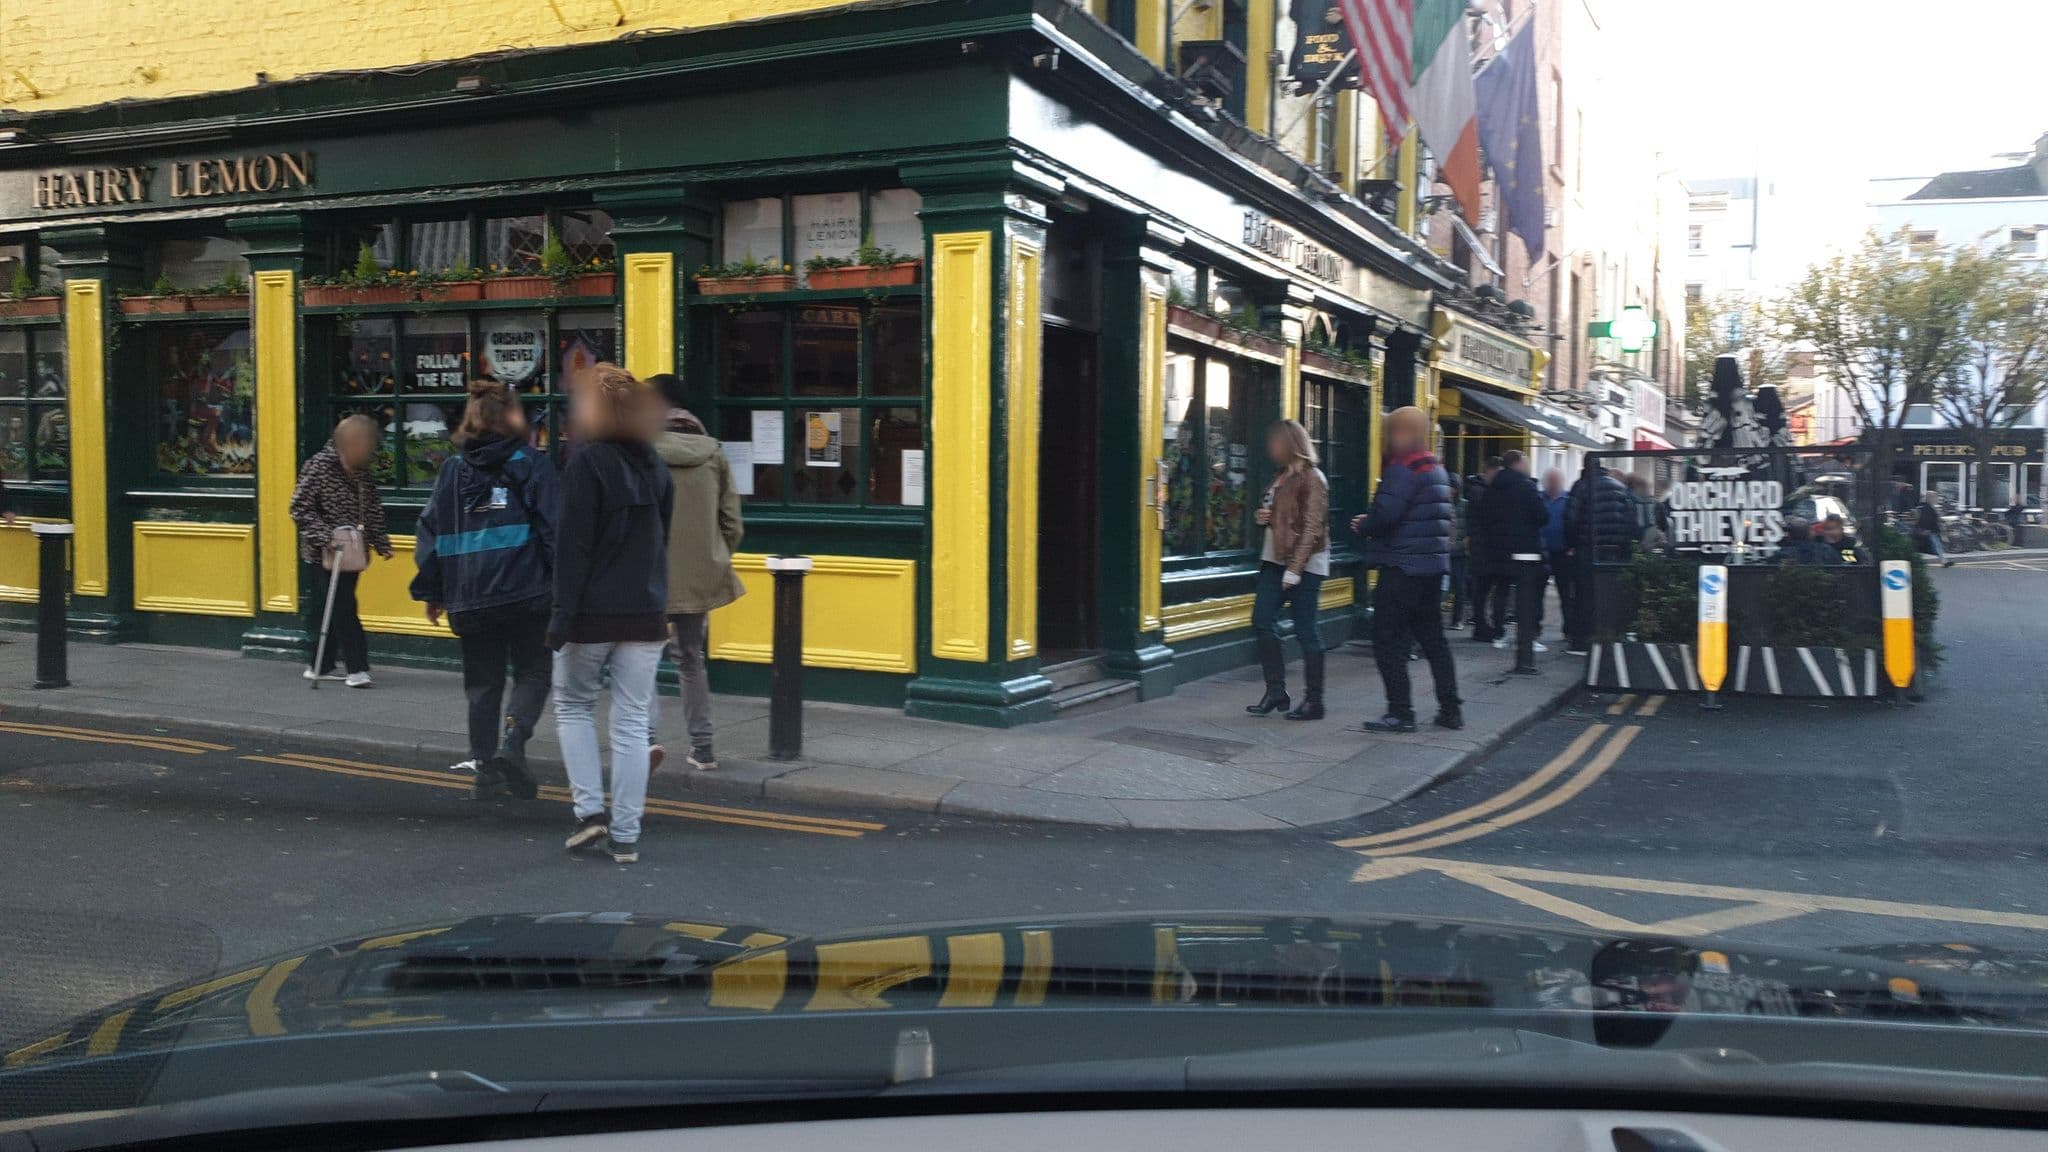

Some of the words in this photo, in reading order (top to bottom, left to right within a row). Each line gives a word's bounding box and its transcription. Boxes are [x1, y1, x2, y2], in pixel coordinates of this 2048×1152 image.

[1304, 33, 1340, 44] FOOD
[31, 166, 150, 209] HAIRY
[169, 150, 313, 198] LEMON
[806, 229, 858, 242] LEMON
[415, 352, 463, 369] FOLLOW
[415, 372, 439, 388] THE
[441, 371, 465, 387] FOX
[1668, 480, 1784, 510] ORCHARD
[1669, 509, 1786, 543] THIEVES
